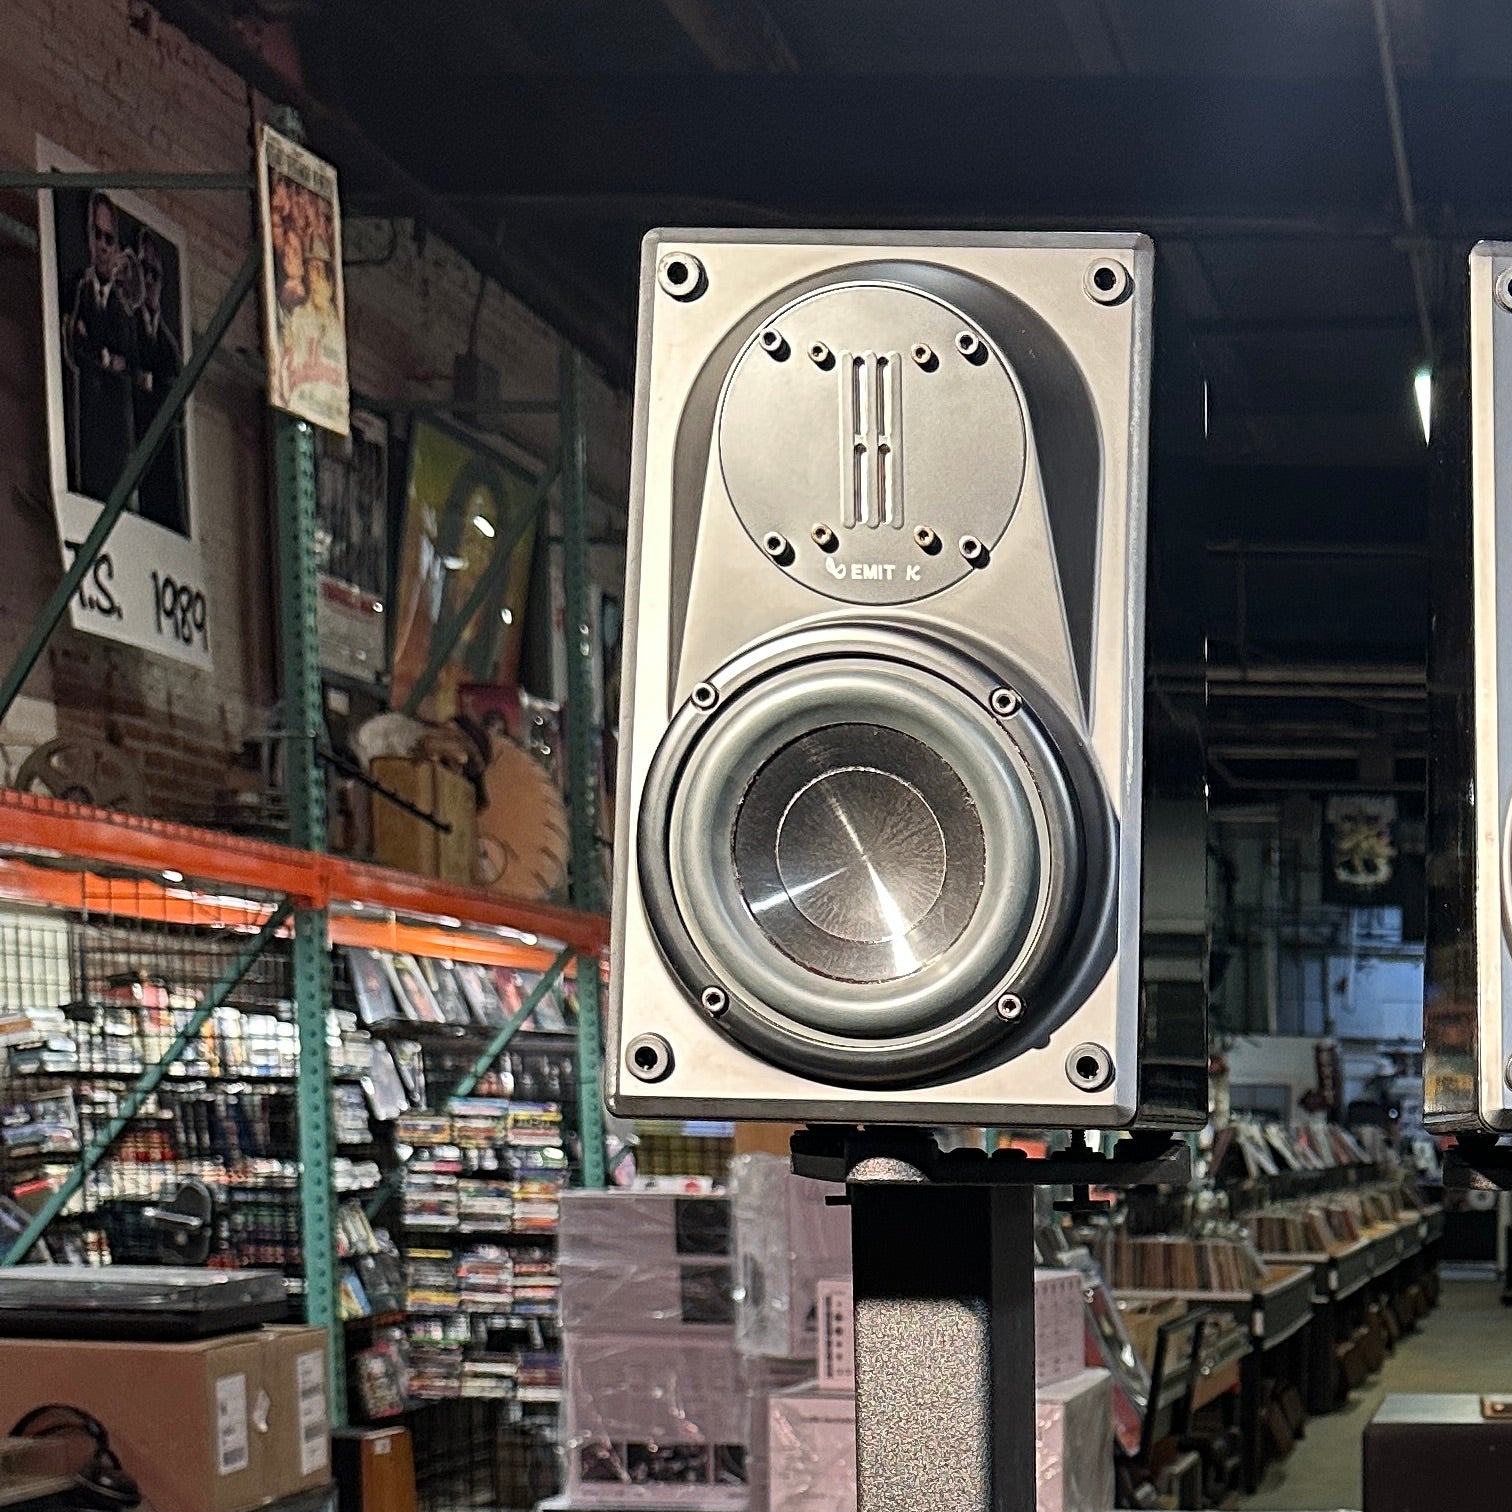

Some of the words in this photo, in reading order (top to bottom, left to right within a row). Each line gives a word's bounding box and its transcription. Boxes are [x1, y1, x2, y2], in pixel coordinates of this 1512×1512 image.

[850, 563, 896, 580] EMIT
[905, 564, 921, 581] K
[151, 570, 209, 652] 1989
